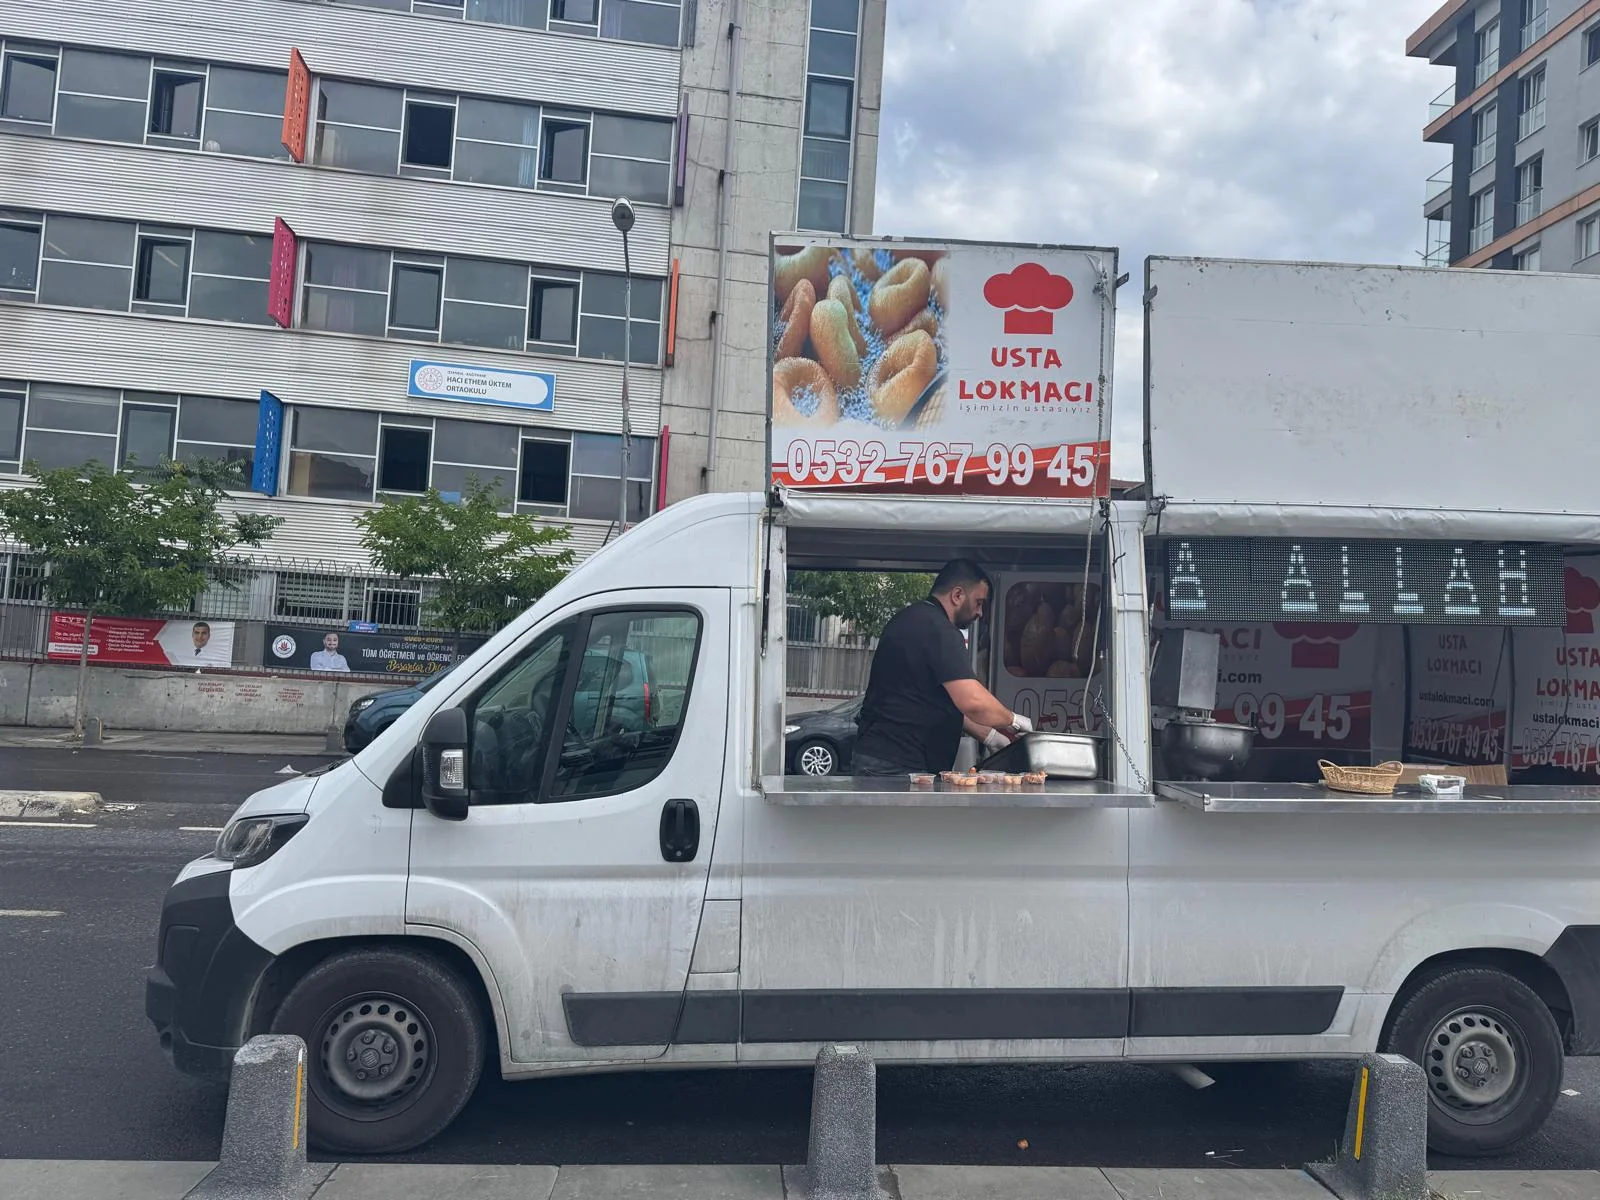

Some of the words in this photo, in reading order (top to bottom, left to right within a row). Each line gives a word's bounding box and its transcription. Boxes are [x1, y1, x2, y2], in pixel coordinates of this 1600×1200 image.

[991, 347, 1062, 369] USTA
[446, 376, 463, 384] HACI
[464, 378, 487, 386] ETHEM
[446, 385, 487, 395] ORTAOKULU
[959, 379, 1092, 403] LOKMACI
[787, 438, 887, 484] 0532
[900, 441, 973, 485] 767
[986, 443, 1034, 486] 99
[1047, 443, 1095, 487] 45
[1282, 545, 1536, 615] ALLAH
[1439, 634, 1468, 651] USTA
[362, 648, 377, 658] TÜM
[379, 648, 416, 660] ÖĞRETMEN
[417, 652, 425, 661] ve
[1427, 658, 1482, 676] LOKMACI
[1419, 691, 1495, 708] ustalokmaci.com
[1536, 678, 1600, 701] LOKMA
[1233, 692, 1286, 740] 99
[1299, 692, 1351, 740] 45
[1532, 712, 1600, 729] ustalokmaci
[1560, 731, 1591, 773] 767
